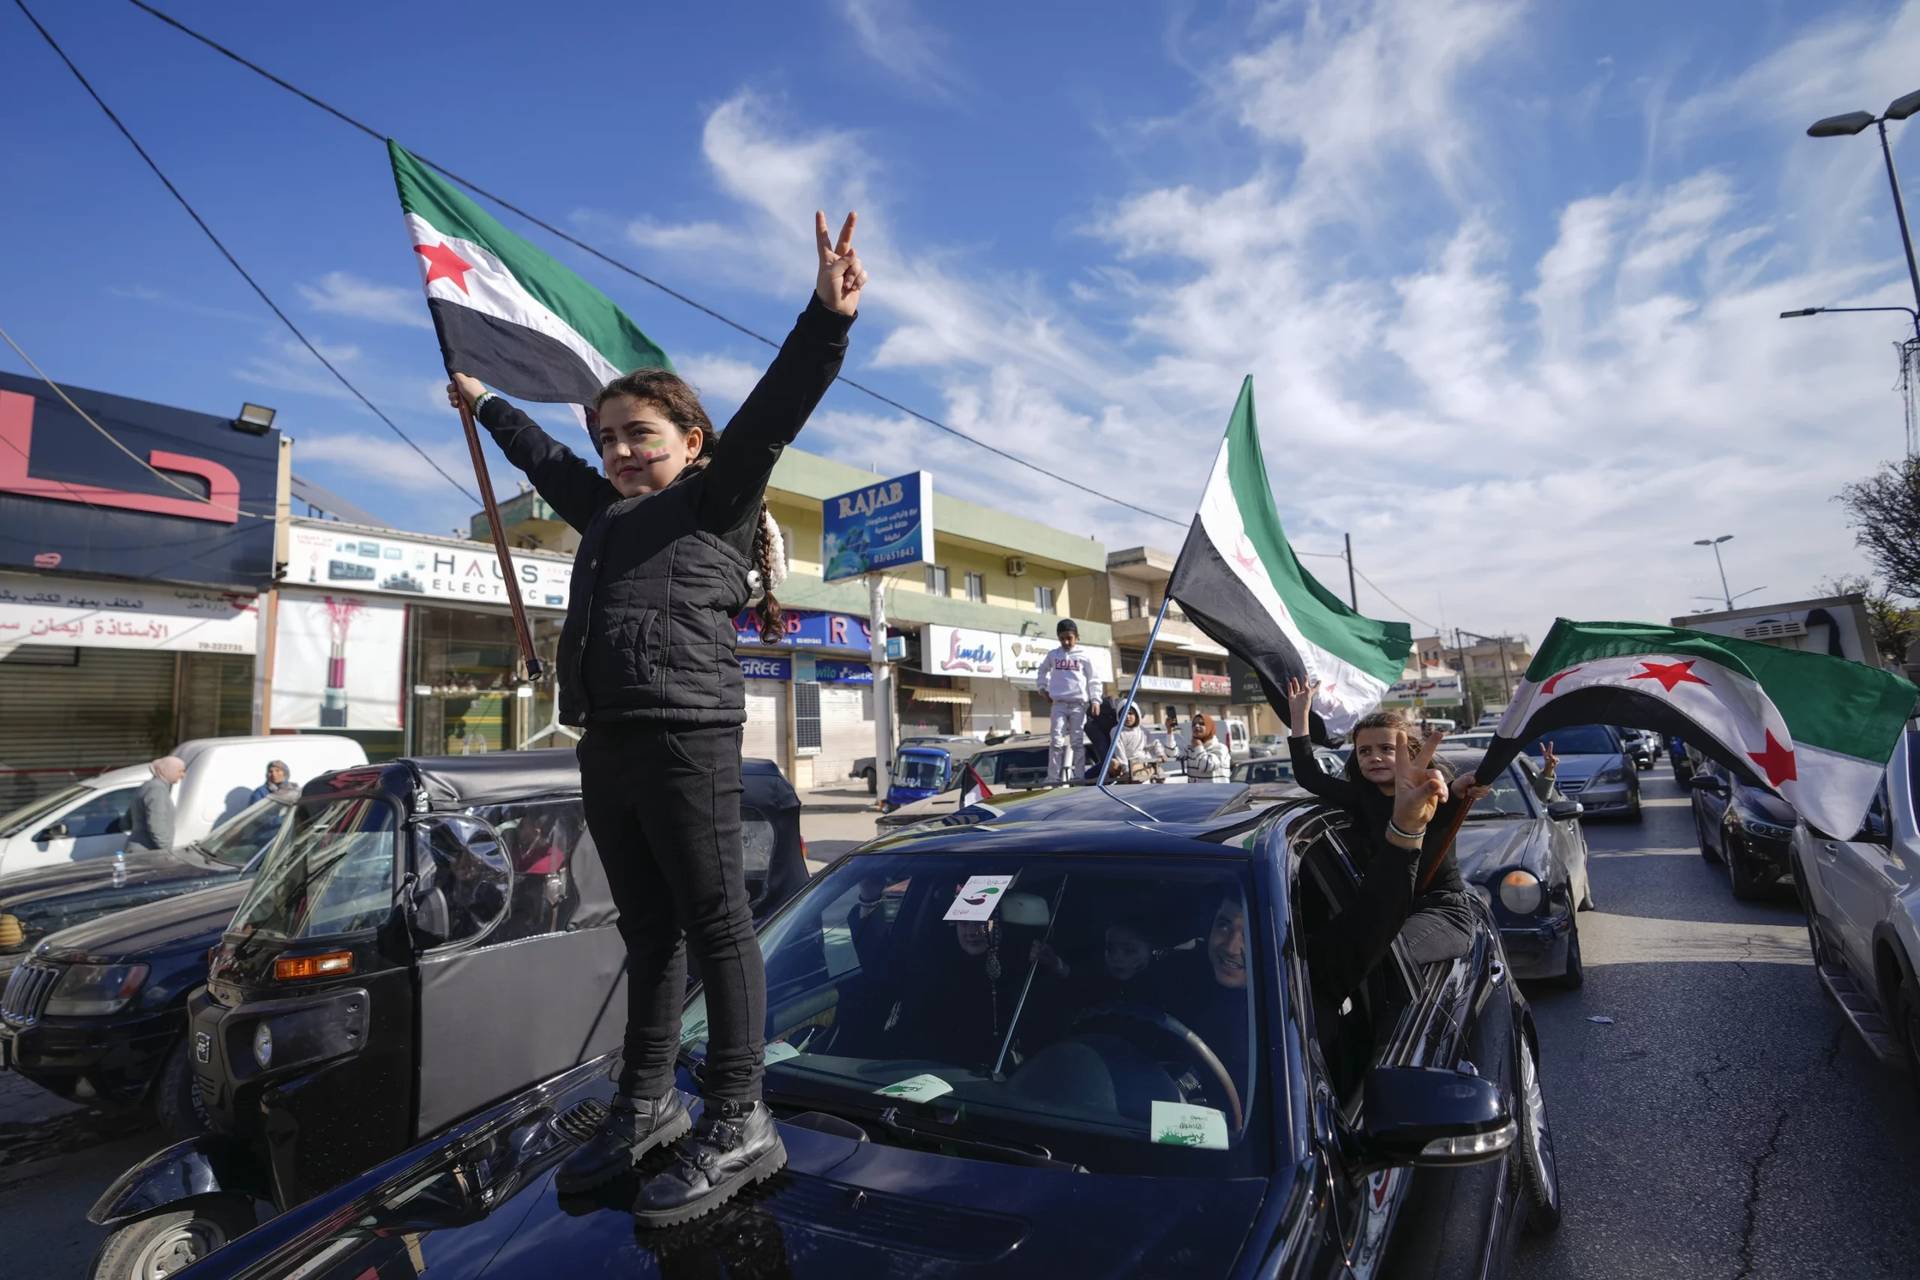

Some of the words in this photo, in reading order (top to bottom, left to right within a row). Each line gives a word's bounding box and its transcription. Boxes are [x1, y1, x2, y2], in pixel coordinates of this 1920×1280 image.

[838, 482, 903, 518] RAJAB
[433, 552, 539, 584] HAUS
[432, 579, 537, 600] ELECTIC
[94, 616, 169, 640] الأستاذة
[741, 658, 781, 676] GREE
